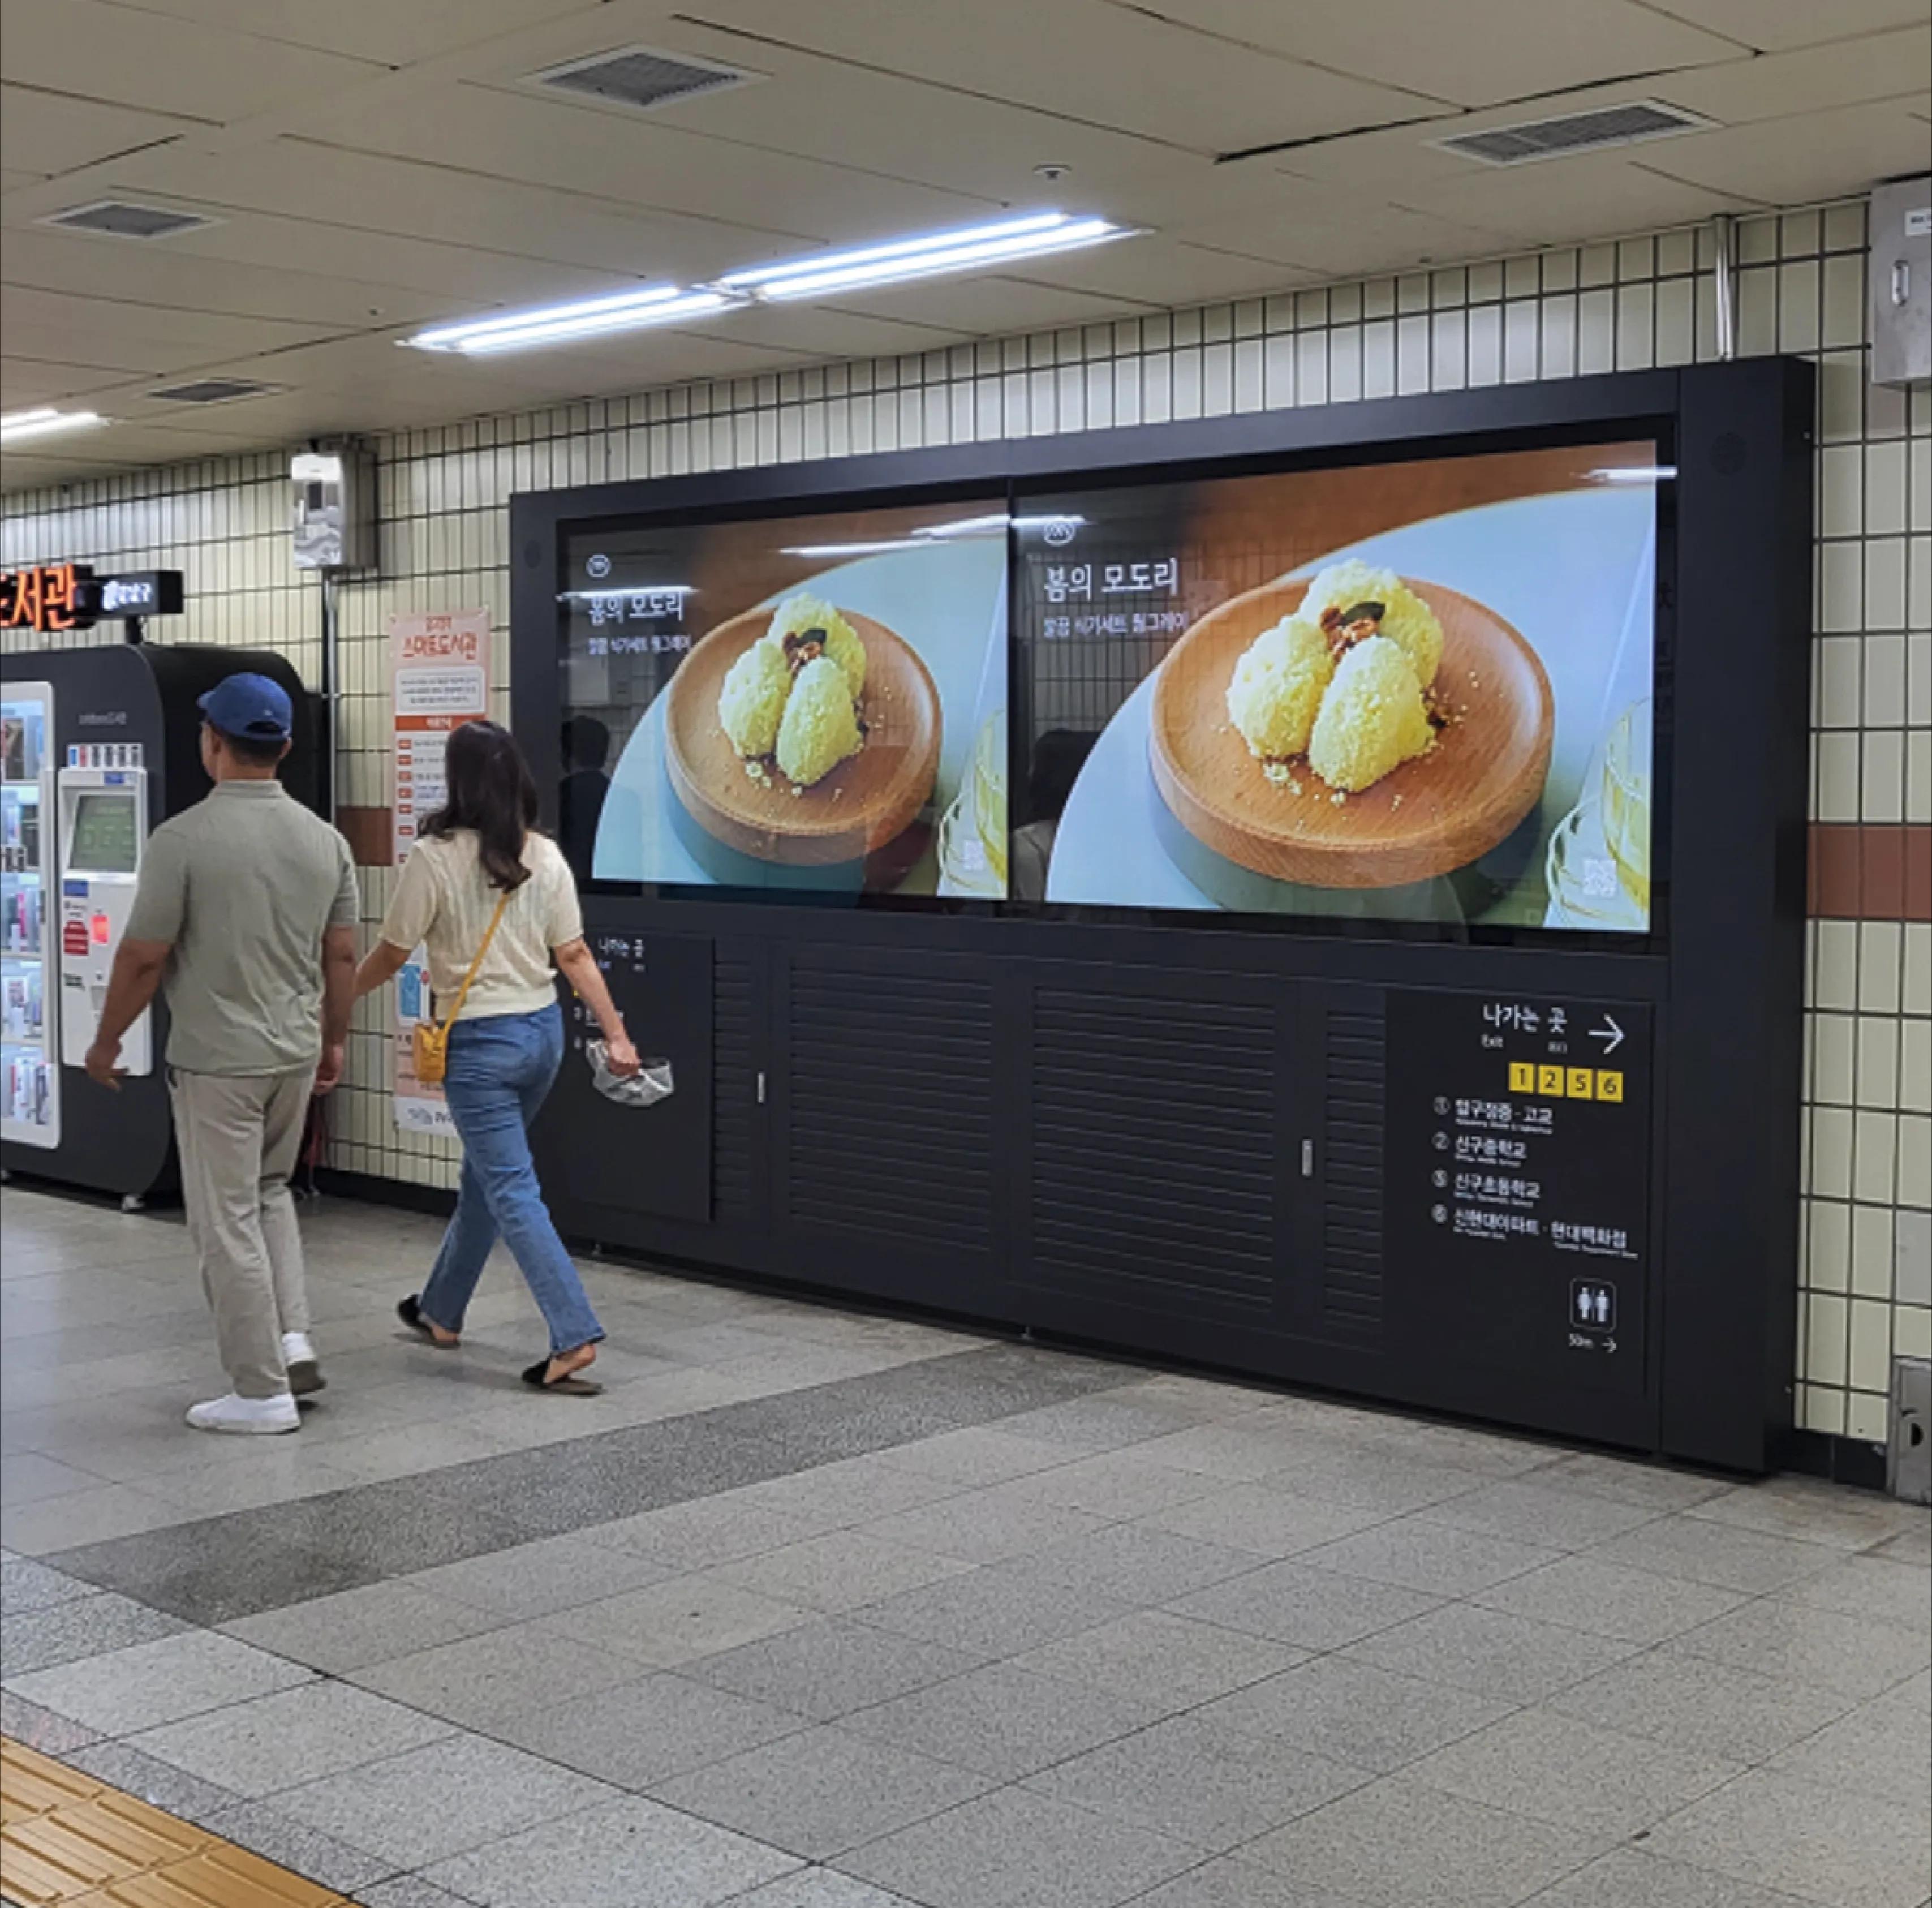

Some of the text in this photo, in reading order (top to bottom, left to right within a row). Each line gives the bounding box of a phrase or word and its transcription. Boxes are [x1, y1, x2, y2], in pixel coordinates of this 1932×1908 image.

[0, 562, 77, 633] 서관
[1044, 558, 1178, 603] 봄의 모도리
[629, 590, 683, 622] 모도리
[1483, 1003, 1568, 1034] 나가는 곳
